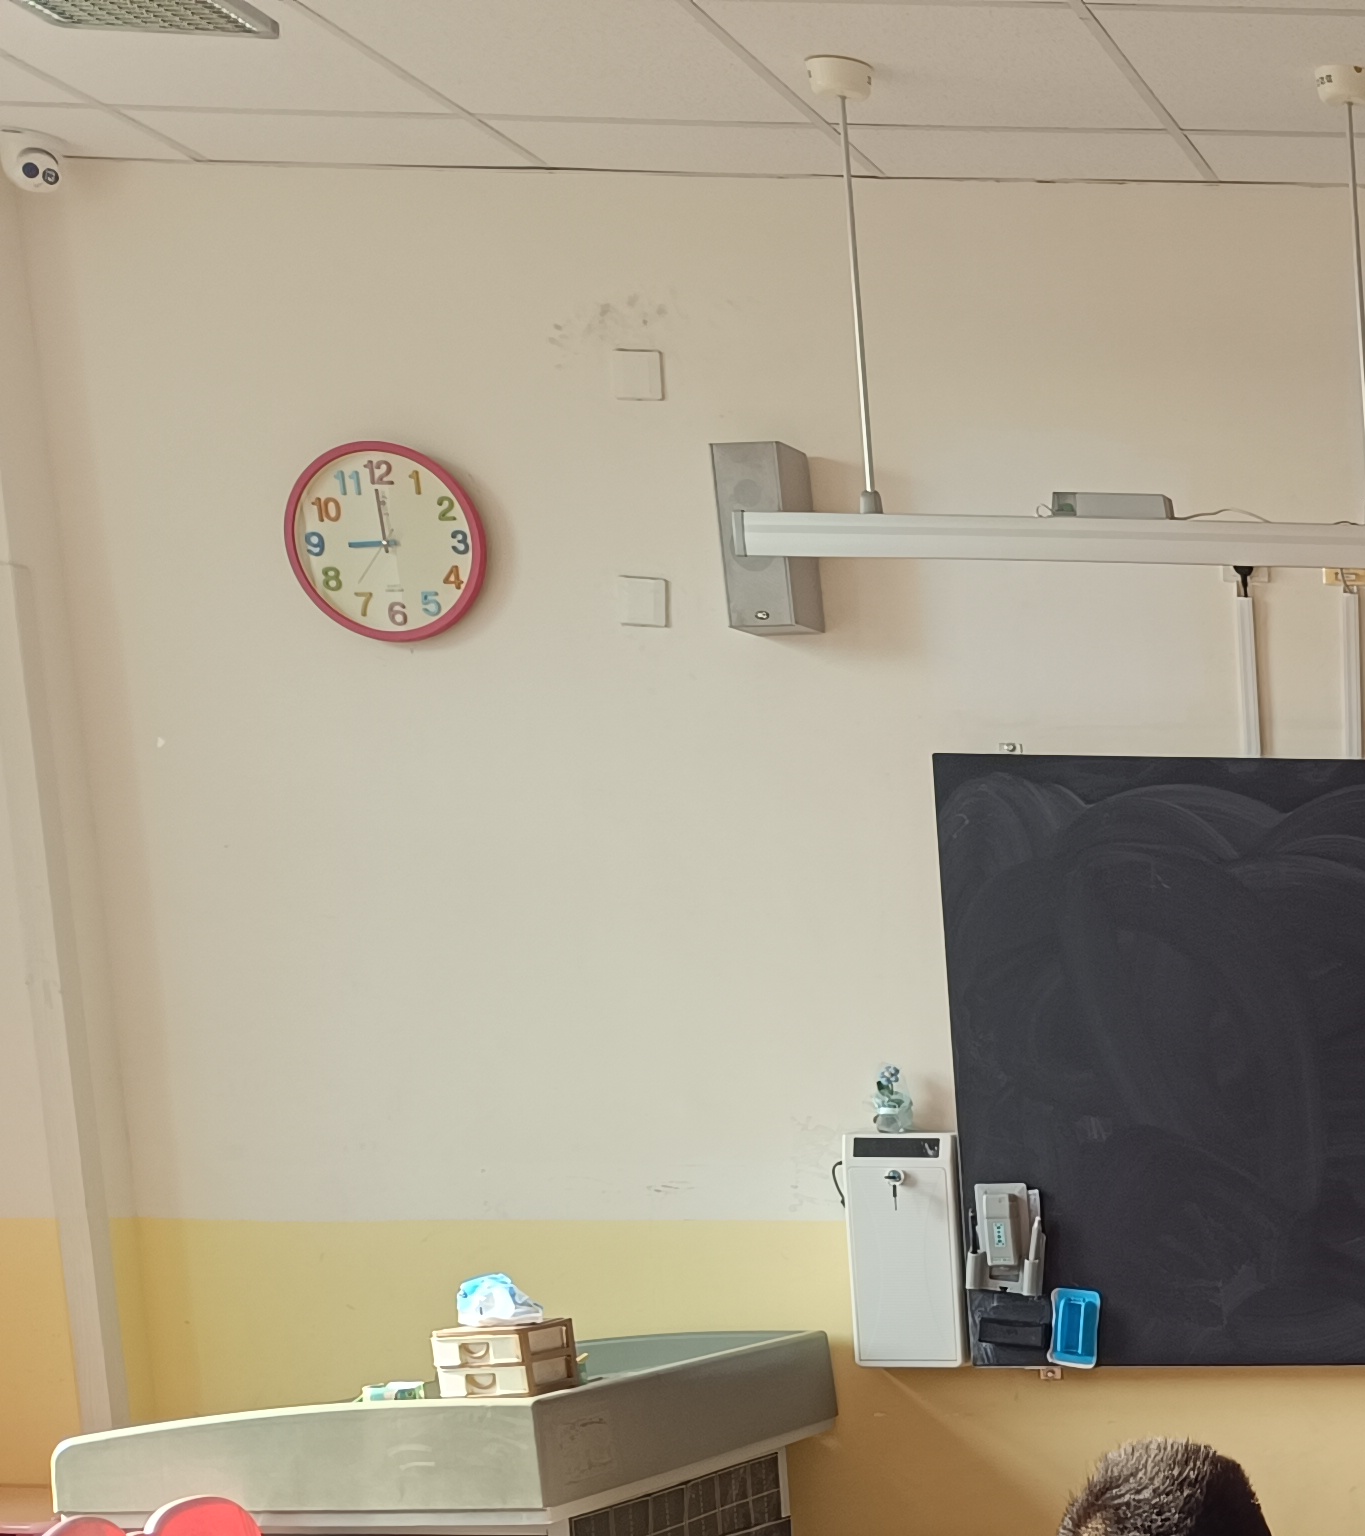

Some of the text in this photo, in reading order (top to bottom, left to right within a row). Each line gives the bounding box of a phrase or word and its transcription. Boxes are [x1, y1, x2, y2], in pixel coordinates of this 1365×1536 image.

[333, 470, 362, 495] 11
[363, 460, 395, 485] 12
[408, 470, 422, 495] 1
[311, 497, 341, 522] 10
[436, 496, 457, 521] 2
[304, 531, 325, 557] 9
[450, 530, 470, 555] 3
[321, 566, 343, 591] 8
[442, 565, 464, 590] 4
[354, 592, 373, 617] 7
[387, 602, 408, 626] 6
[420, 591, 442, 616] 5
